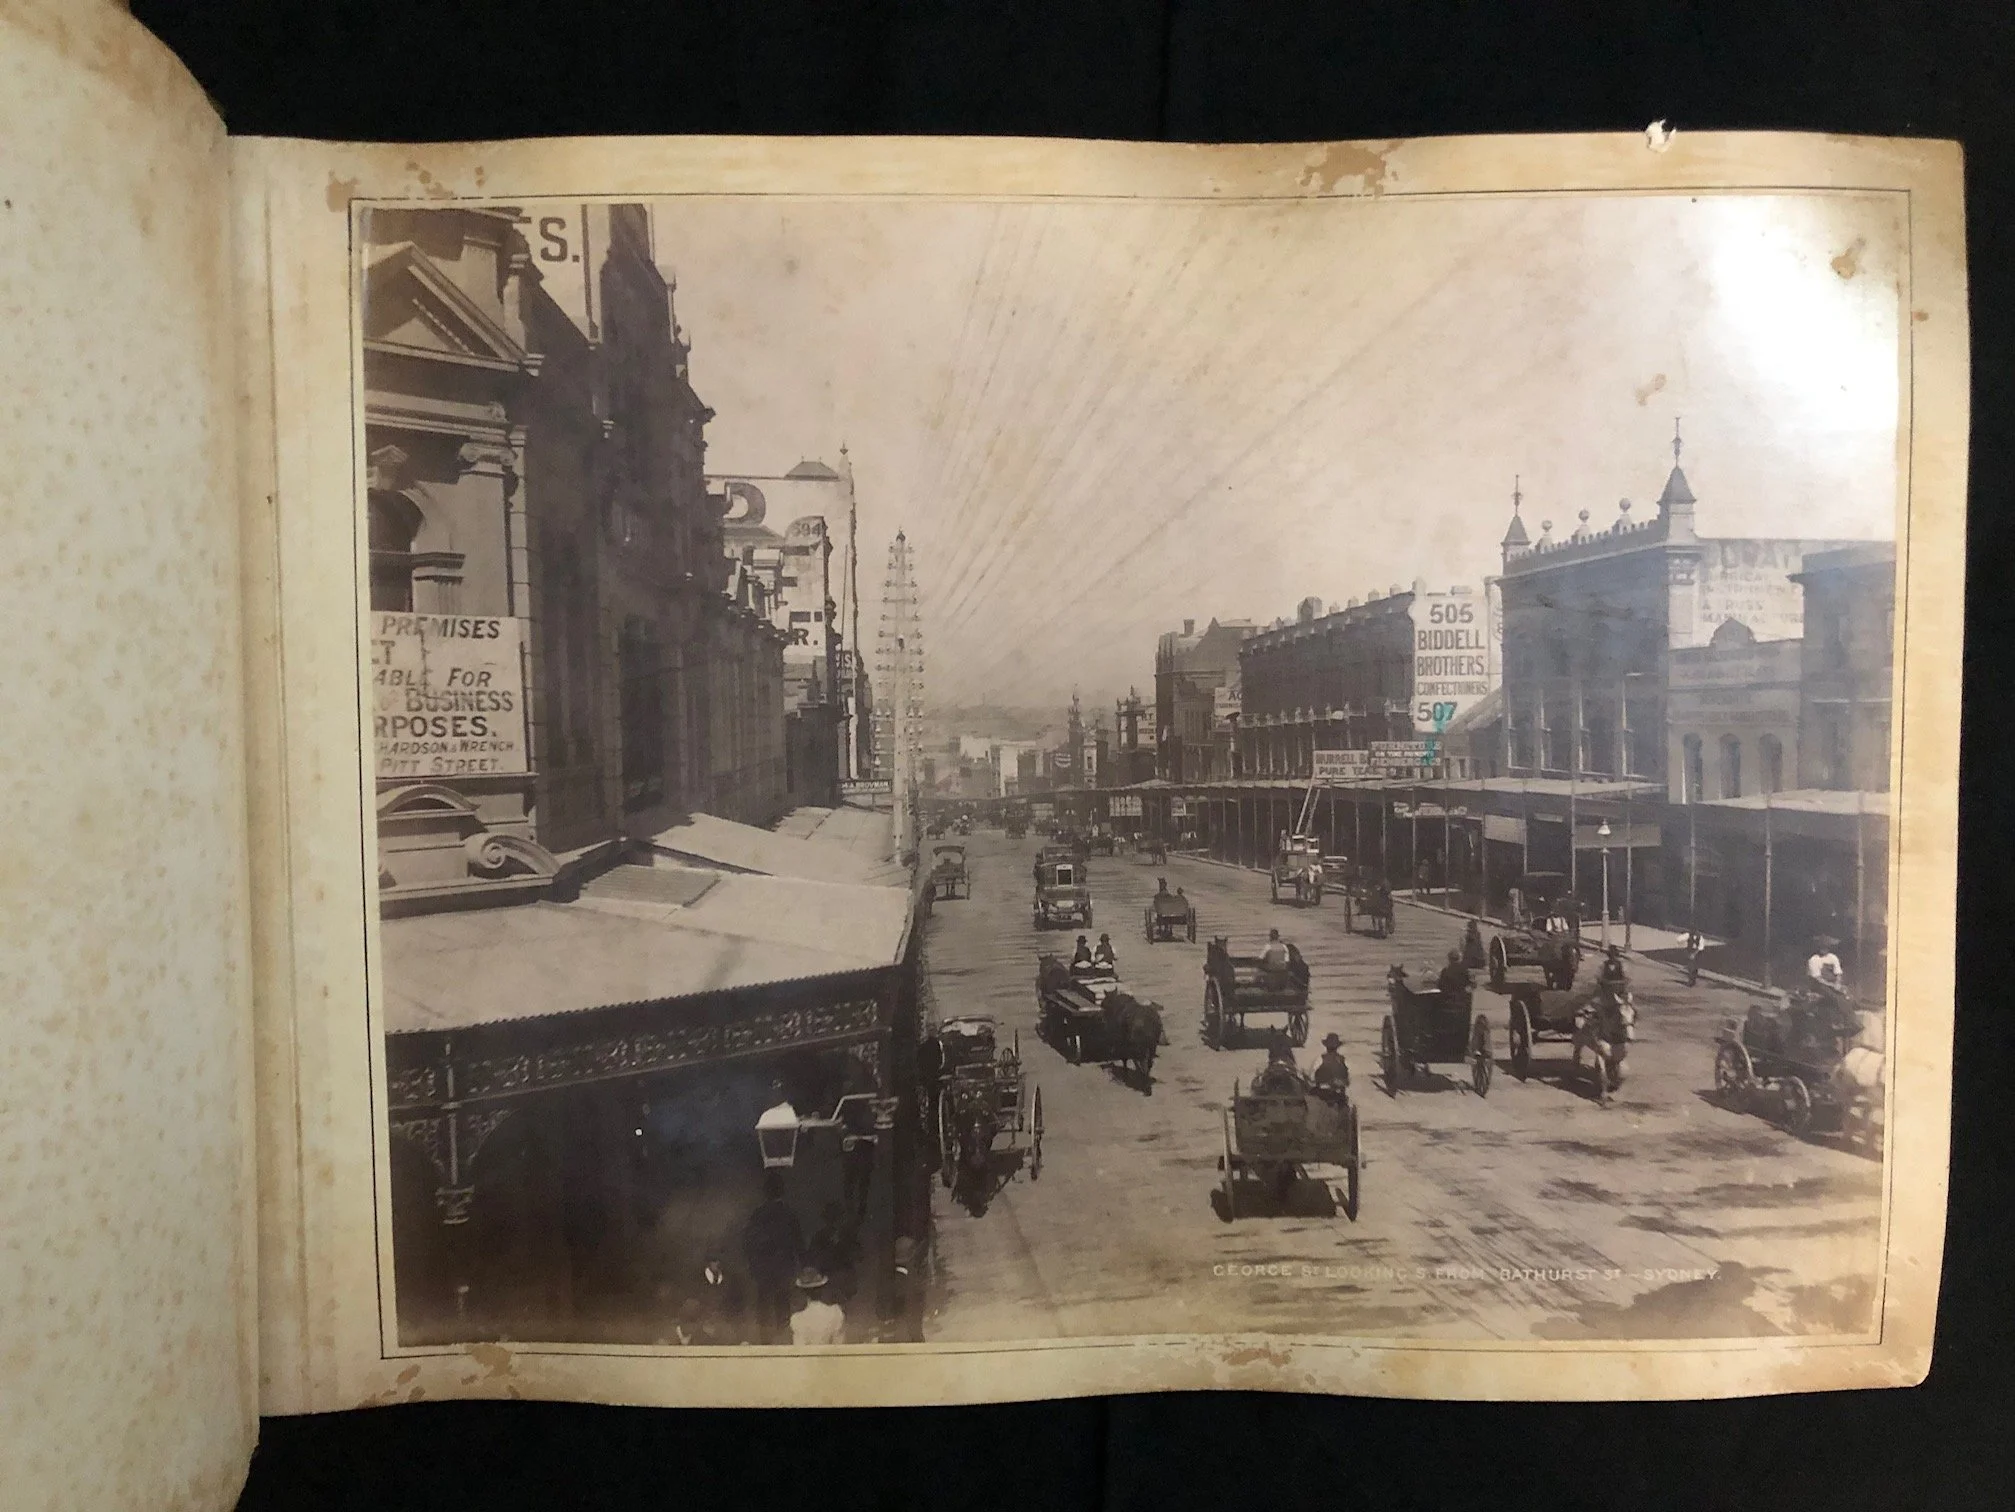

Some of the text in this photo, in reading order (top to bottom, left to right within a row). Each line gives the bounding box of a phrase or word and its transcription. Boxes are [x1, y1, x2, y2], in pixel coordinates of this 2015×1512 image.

[519, 216, 580, 262] S.
[1430, 603, 1474, 624] 505
[382, 616, 500, 638] PREMISES
[1417, 629, 1485, 650] BIDDELL
[1417, 655, 1485, 676] BROTHERS
[448, 667, 491, 687] FOR
[406, 688, 513, 712] BUSINESS
[1417, 702, 1457, 722] 507
[380, 758, 421, 773] PITT
